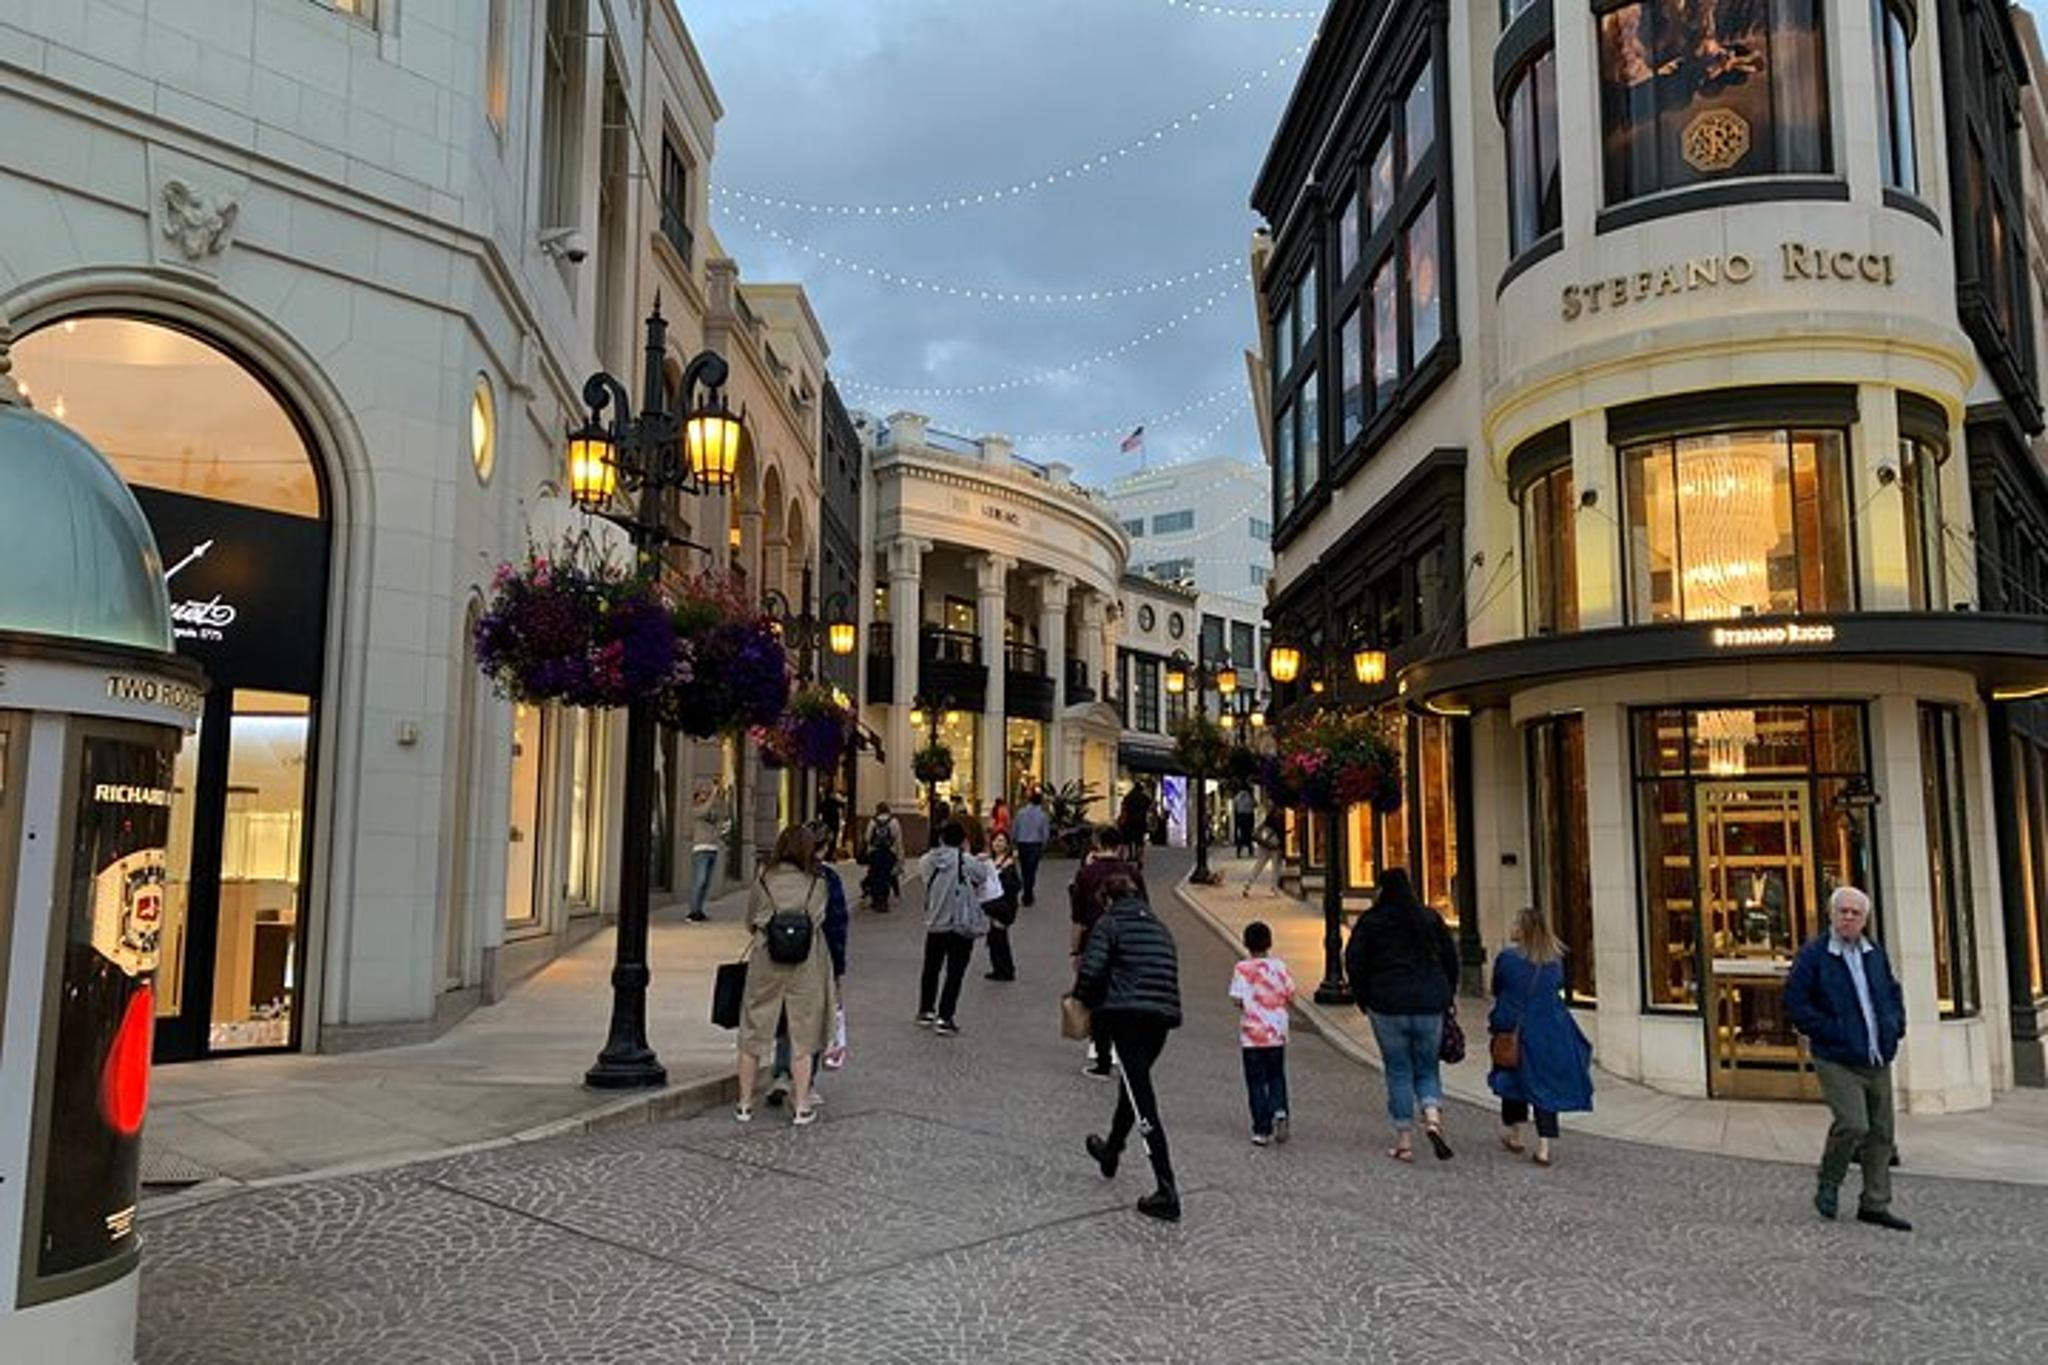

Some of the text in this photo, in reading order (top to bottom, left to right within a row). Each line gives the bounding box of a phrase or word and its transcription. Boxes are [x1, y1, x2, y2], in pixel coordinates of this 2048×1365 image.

[1561, 241, 1897, 322] STEFANO RICCI
[1711, 622, 1836, 647] STEFANO RICCI
[107, 676, 157, 700] TWO
